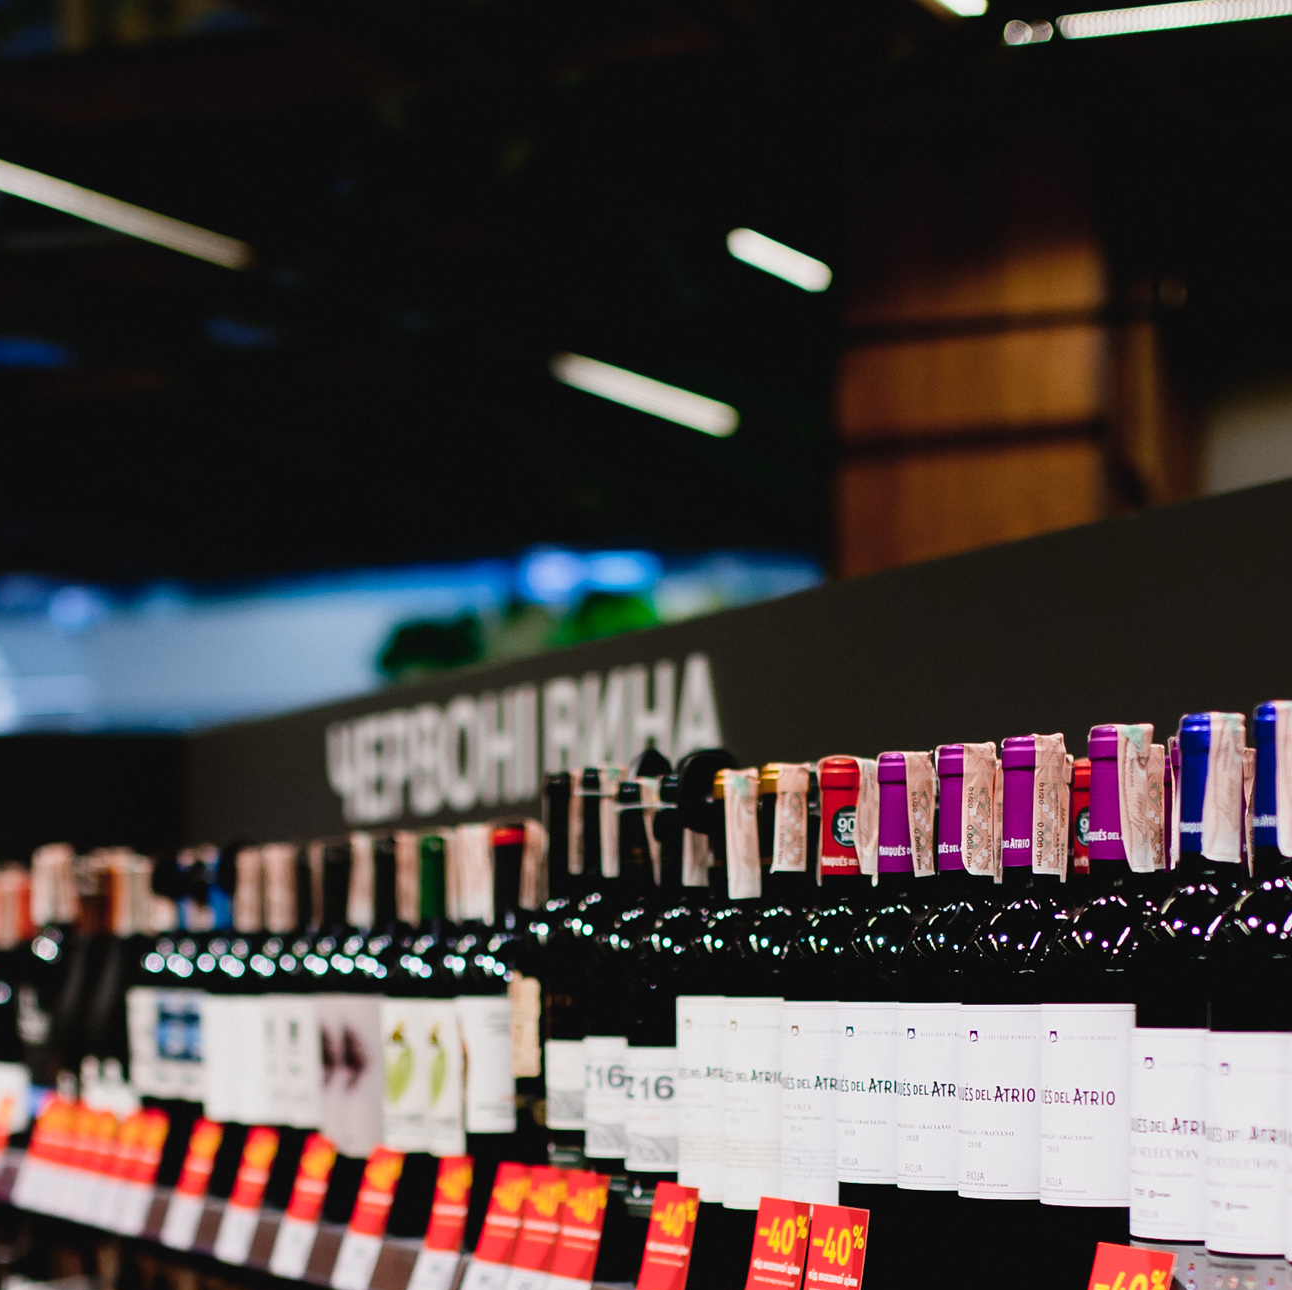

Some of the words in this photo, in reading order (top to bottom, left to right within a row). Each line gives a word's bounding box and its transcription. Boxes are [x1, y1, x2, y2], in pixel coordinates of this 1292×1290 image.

[326, 682, 538, 824] ЧЕРВОНІ
[542, 653, 723, 780] ВИНА
[1010, 837, 1030, 850] ATRIO
[797, 1079, 811, 1090] DEL
[851, 1080, 866, 1093] DEL
[913, 1084, 929, 1096] DEL
[975, 1089, 992, 1101] DEL
[994, 1086, 1036, 1103] ATRIO
[1054, 1091, 1070, 1104] DEL
[1073, 1088, 1115, 1106] ATRIO
[1150, 1119, 1167, 1133] DEL
[757, 1215, 808, 1256] -40%
[812, 1225, 865, 1267] -40%
